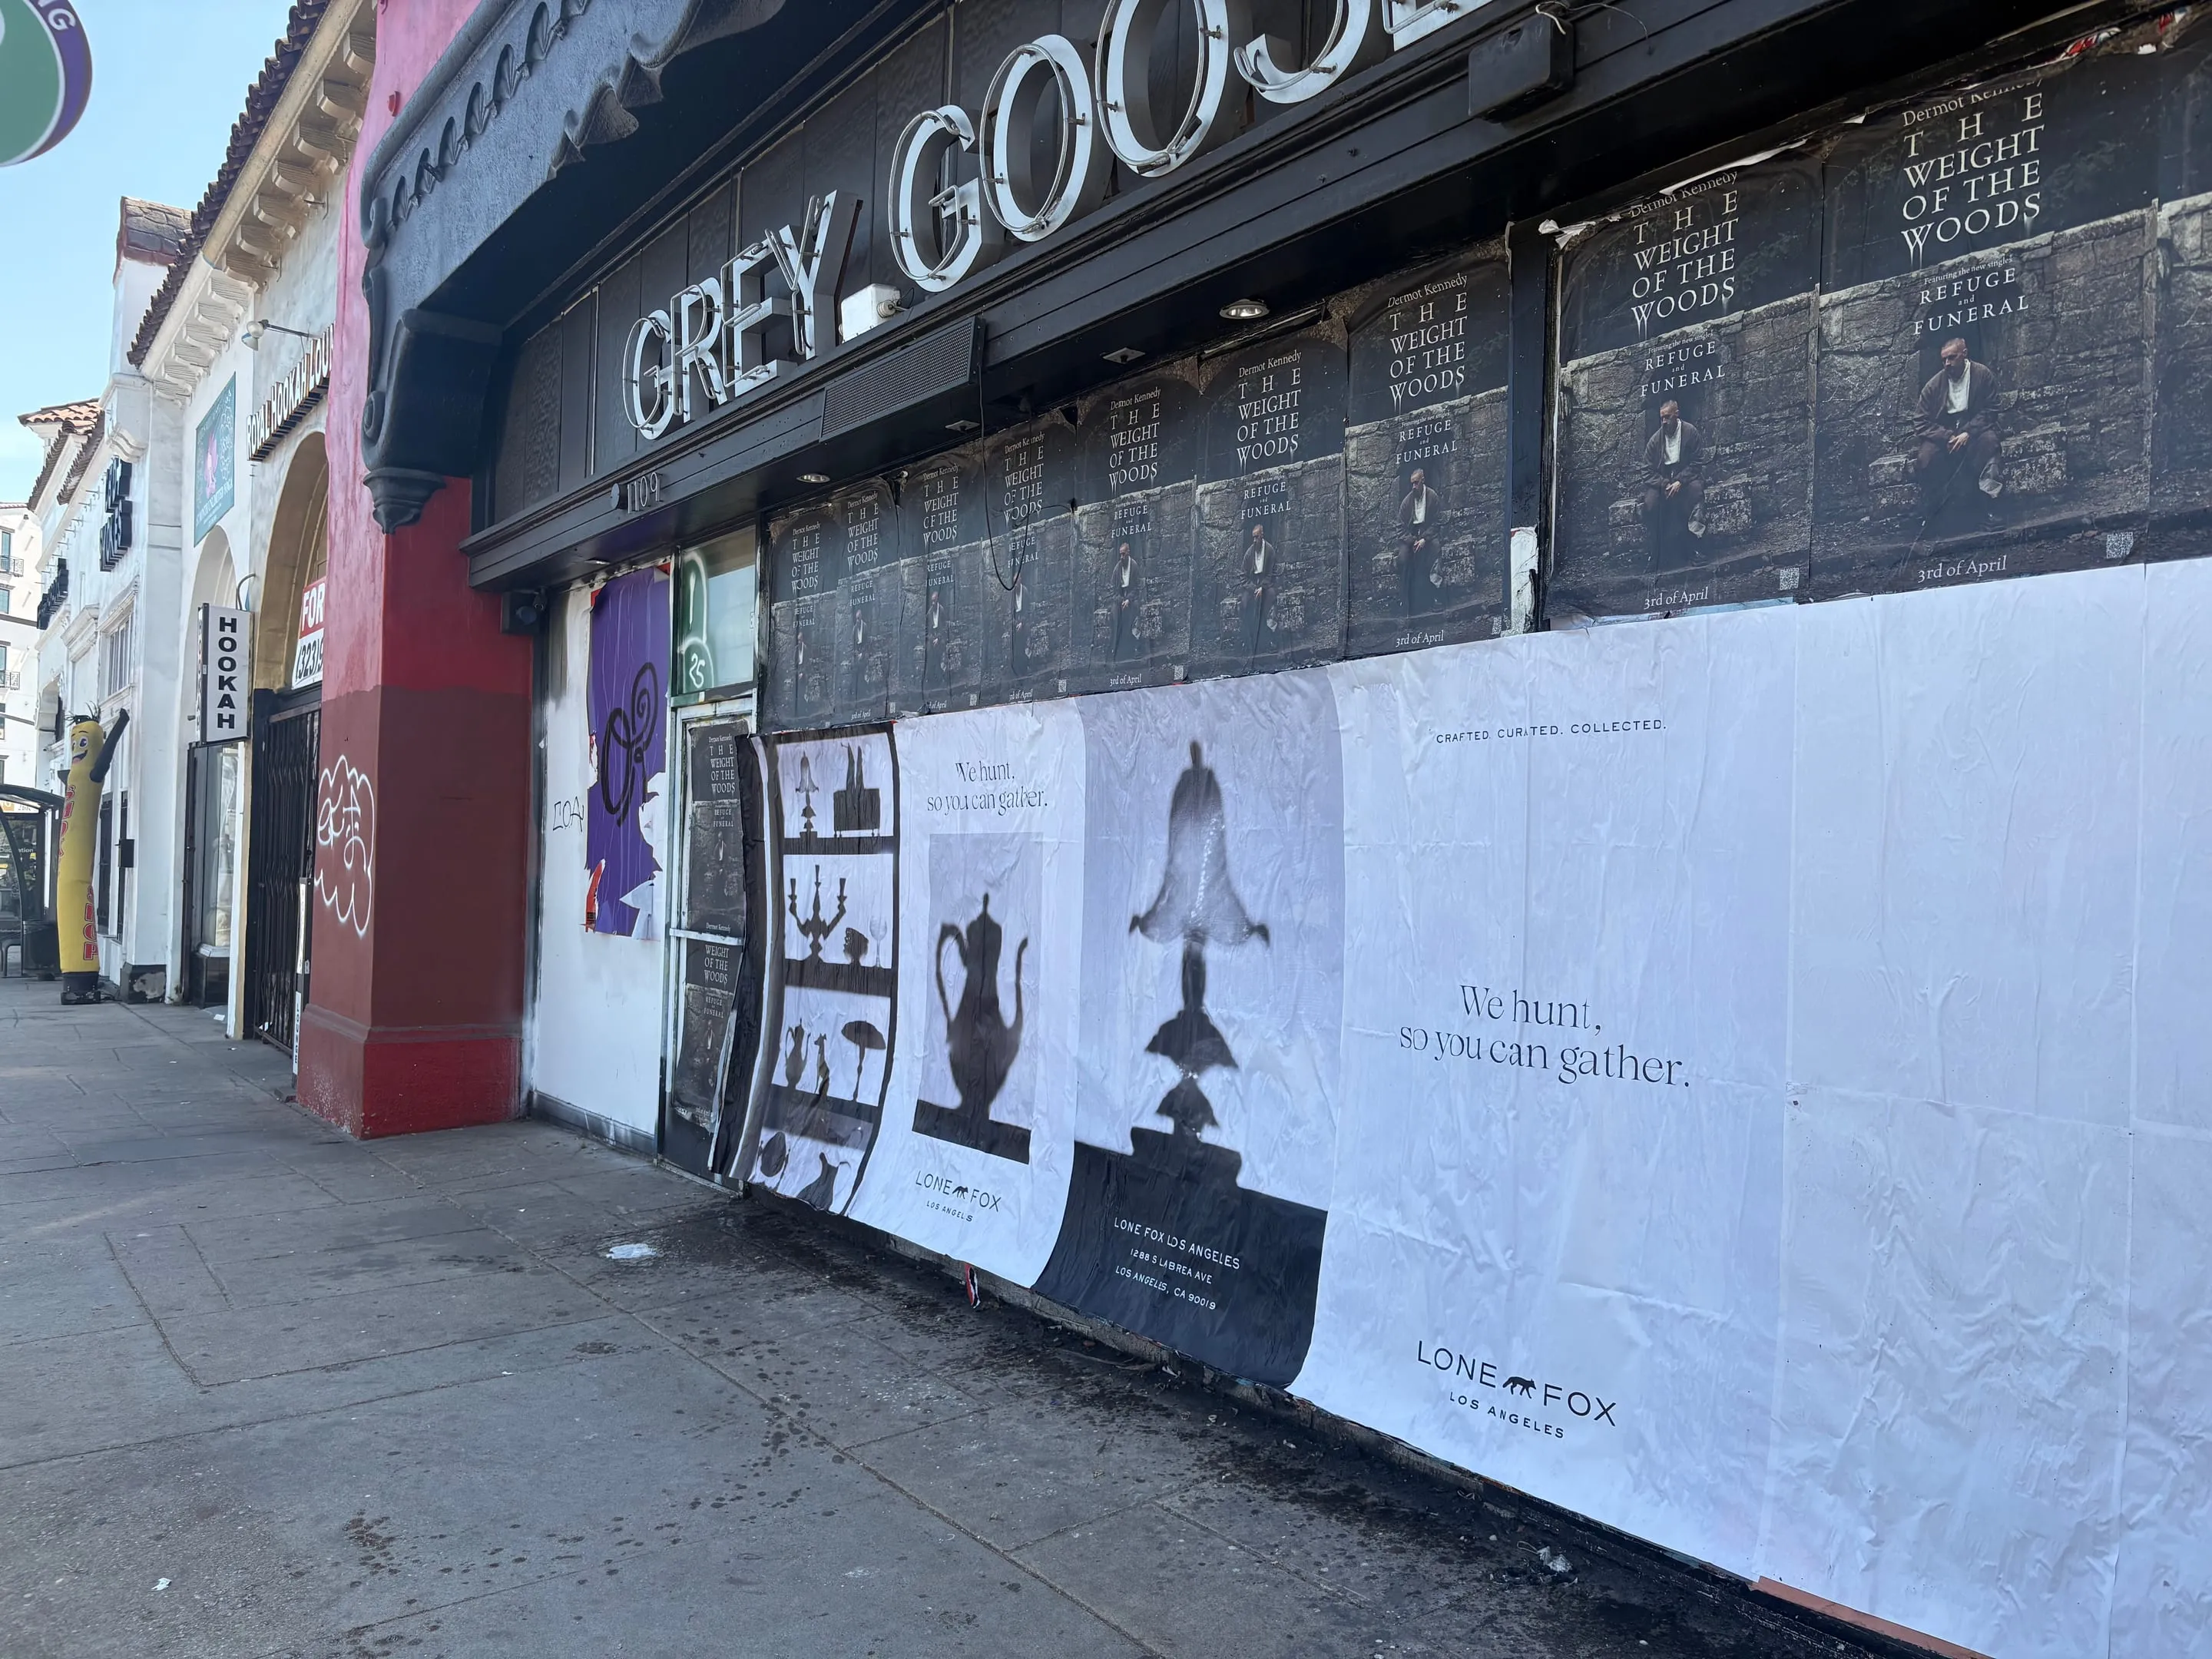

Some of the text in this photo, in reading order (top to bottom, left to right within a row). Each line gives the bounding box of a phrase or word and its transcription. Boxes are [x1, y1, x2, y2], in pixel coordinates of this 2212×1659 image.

[1902, 96, 1965, 127] Dermot
[1903, 92, 2042, 158] THE
[1903, 124, 2045, 189] WEIGHT
[1902, 160, 2040, 220] OF THE
[621, 0, 1492, 441] GREY GOO
[1634, 190, 1737, 245] THE
[1901, 192, 2041, 255] WOODS
[1634, 217, 1738, 271] WEIGHT
[1633, 248, 1735, 299] OF THE
[1919, 267, 2015, 306] REFUGE
[1924, 272, 1957, 285] Featuring
[1959, 267, 1970, 276] the
[1388, 273, 1468, 308] Dermot Kennedy
[1631, 276, 1735, 332] WOODS
[1958, 294, 1975, 306] and
[1389, 292, 1467, 332] THE
[1913, 294, 2029, 336] FUNERAL
[1390, 316, 1468, 354] WEIGHT
[1239, 349, 1302, 378] Dermot Kennedy
[1389, 341, 1465, 379] OF THE
[1644, 341, 1715, 372] REFUGE
[1134, 387, 1161, 403] Kennedy
[1239, 367, 1301, 399] THE
[1389, 366, 1465, 406] WOODS
[1640, 365, 1726, 398] FUNERAL
[247, 400, 272, 460] ROYAL
[271, 353, 310, 434] HOOKAH
[1238, 389, 1301, 421] WEIGHT
[1111, 422, 1161, 449] WEIGHT
[1237, 412, 1299, 442] OF THE
[1399, 419, 1451, 442] REFUGE
[1110, 442, 1157, 469] OF THE
[1237, 434, 1299, 468] WOODS
[1396, 440, 1458, 465] FUNERAL
[1005, 463, 1044, 488] WEIGHT
[1109, 462, 1157, 489] WOODS
[627, 472, 658, 514] 1109
[924, 492, 959, 513] WEIGHT
[1020, 482, 1042, 501] THE
[1243, 482, 1286, 499] REFUGE
[939, 509, 958, 525] THE
[1114, 505, 1148, 520] REFUGE
[1241, 501, 1291, 520] FUNERAL
[848, 518, 879, 538] WEIGHT
[923, 525, 957, 547] WOODS
[1111, 522, 1152, 538] FUNERAL
[793, 547, 820, 563] WEIGHT
[847, 533, 878, 553] OF THE
[803, 561, 819, 575] THE
[847, 548, 878, 568] WOODS
[1918, 555, 2007, 583] 3rd of April
[791, 575, 818, 591] WOODS
[301, 582, 326, 631] FOR
[1644, 586, 1709, 610] 3rd of April
[1396, 630, 1444, 647] 3rd of April
[217, 617, 237, 729] HOOKAH
[1127, 674, 1141, 685] April
[1436, 730, 1491, 743] CRAFTED.
[1571, 720, 1667, 734] COLLECTED.
[710, 757, 734, 768] WEIGHT
[711, 770, 734, 781] OF THE
[955, 762, 976, 782] We
[711, 783, 735, 794] WOODS
[927, 786, 1048, 816] so you can gather.
[704, 957, 728, 971] OF THE
[705, 945, 730, 959] WEIGHT
[704, 969, 727, 984] WOODS
[1460, 984, 1602, 1035] We hunt,
[1400, 1025, 1690, 1088] so you can gather.
[916, 1170, 1002, 1212] LONE FOX
[926, 1200, 940, 1210] LOS
[1114, 1217, 1240, 1270] LONE FOX LOS ANGELES
[1131, 1248, 1150, 1261] 1288
[1152, 1255, 1157, 1264] S
[1194, 1271, 1213, 1285] AVE
[1115, 1266, 1132, 1278] LOS
[1174, 1288, 1186, 1299] CA
[1188, 1293, 1216, 1310] 90019
[1417, 1340, 1616, 1427] LONE FOX
[1449, 1392, 1565, 1439] LOS ANGELES
